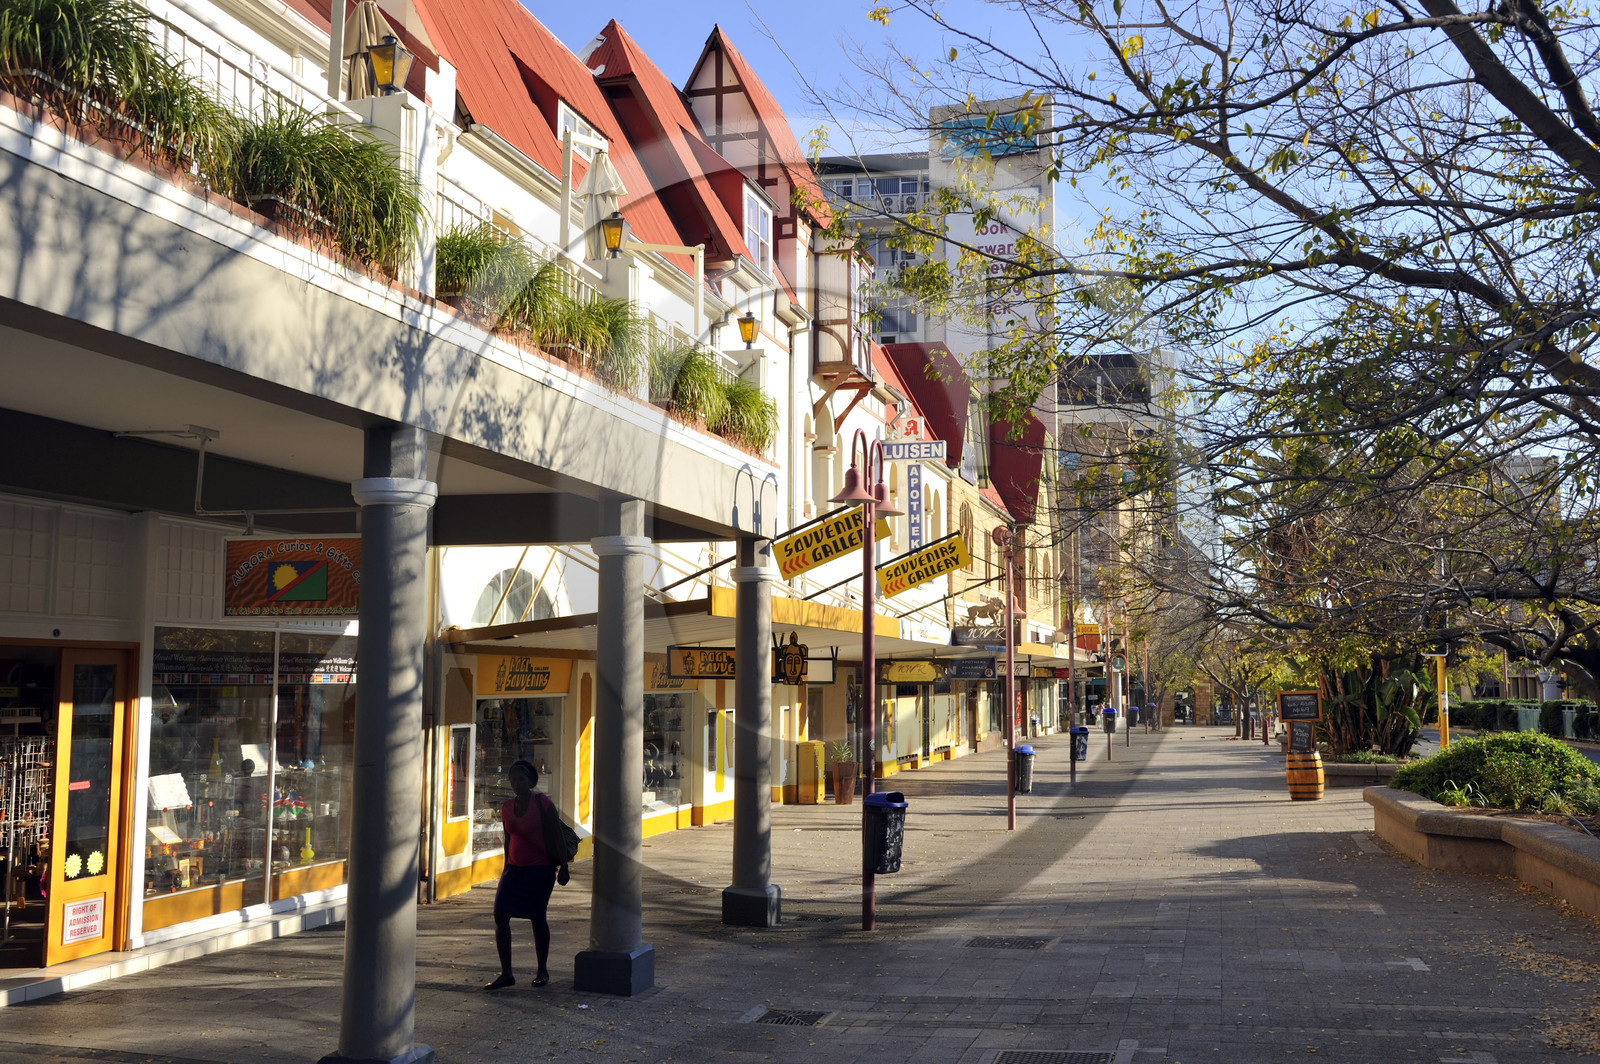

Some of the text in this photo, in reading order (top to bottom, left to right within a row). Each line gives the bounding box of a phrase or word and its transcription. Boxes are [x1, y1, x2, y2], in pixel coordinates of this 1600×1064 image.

[976, 222, 1008, 236] ook
[883, 443, 943, 459] LUISEN
[909, 466, 921, 551] APOTHEK
[784, 513, 863, 557] SOUVENIR
[812, 526, 868, 563] GALLE
[232, 547, 274, 586] AURORA
[277, 540, 311, 553] Curios
[315, 542, 323, 554] &
[327, 547, 353, 571] Gifts
[908, 554, 960, 585] GALLERY
[699, 662, 735, 675] SOUVE
[897, 664, 927, 675] NWR
[71, 903, 97, 916] RIGHT OF
[69, 914, 98, 927] ADMISSION
[69, 924, 98, 937] RESERVED
